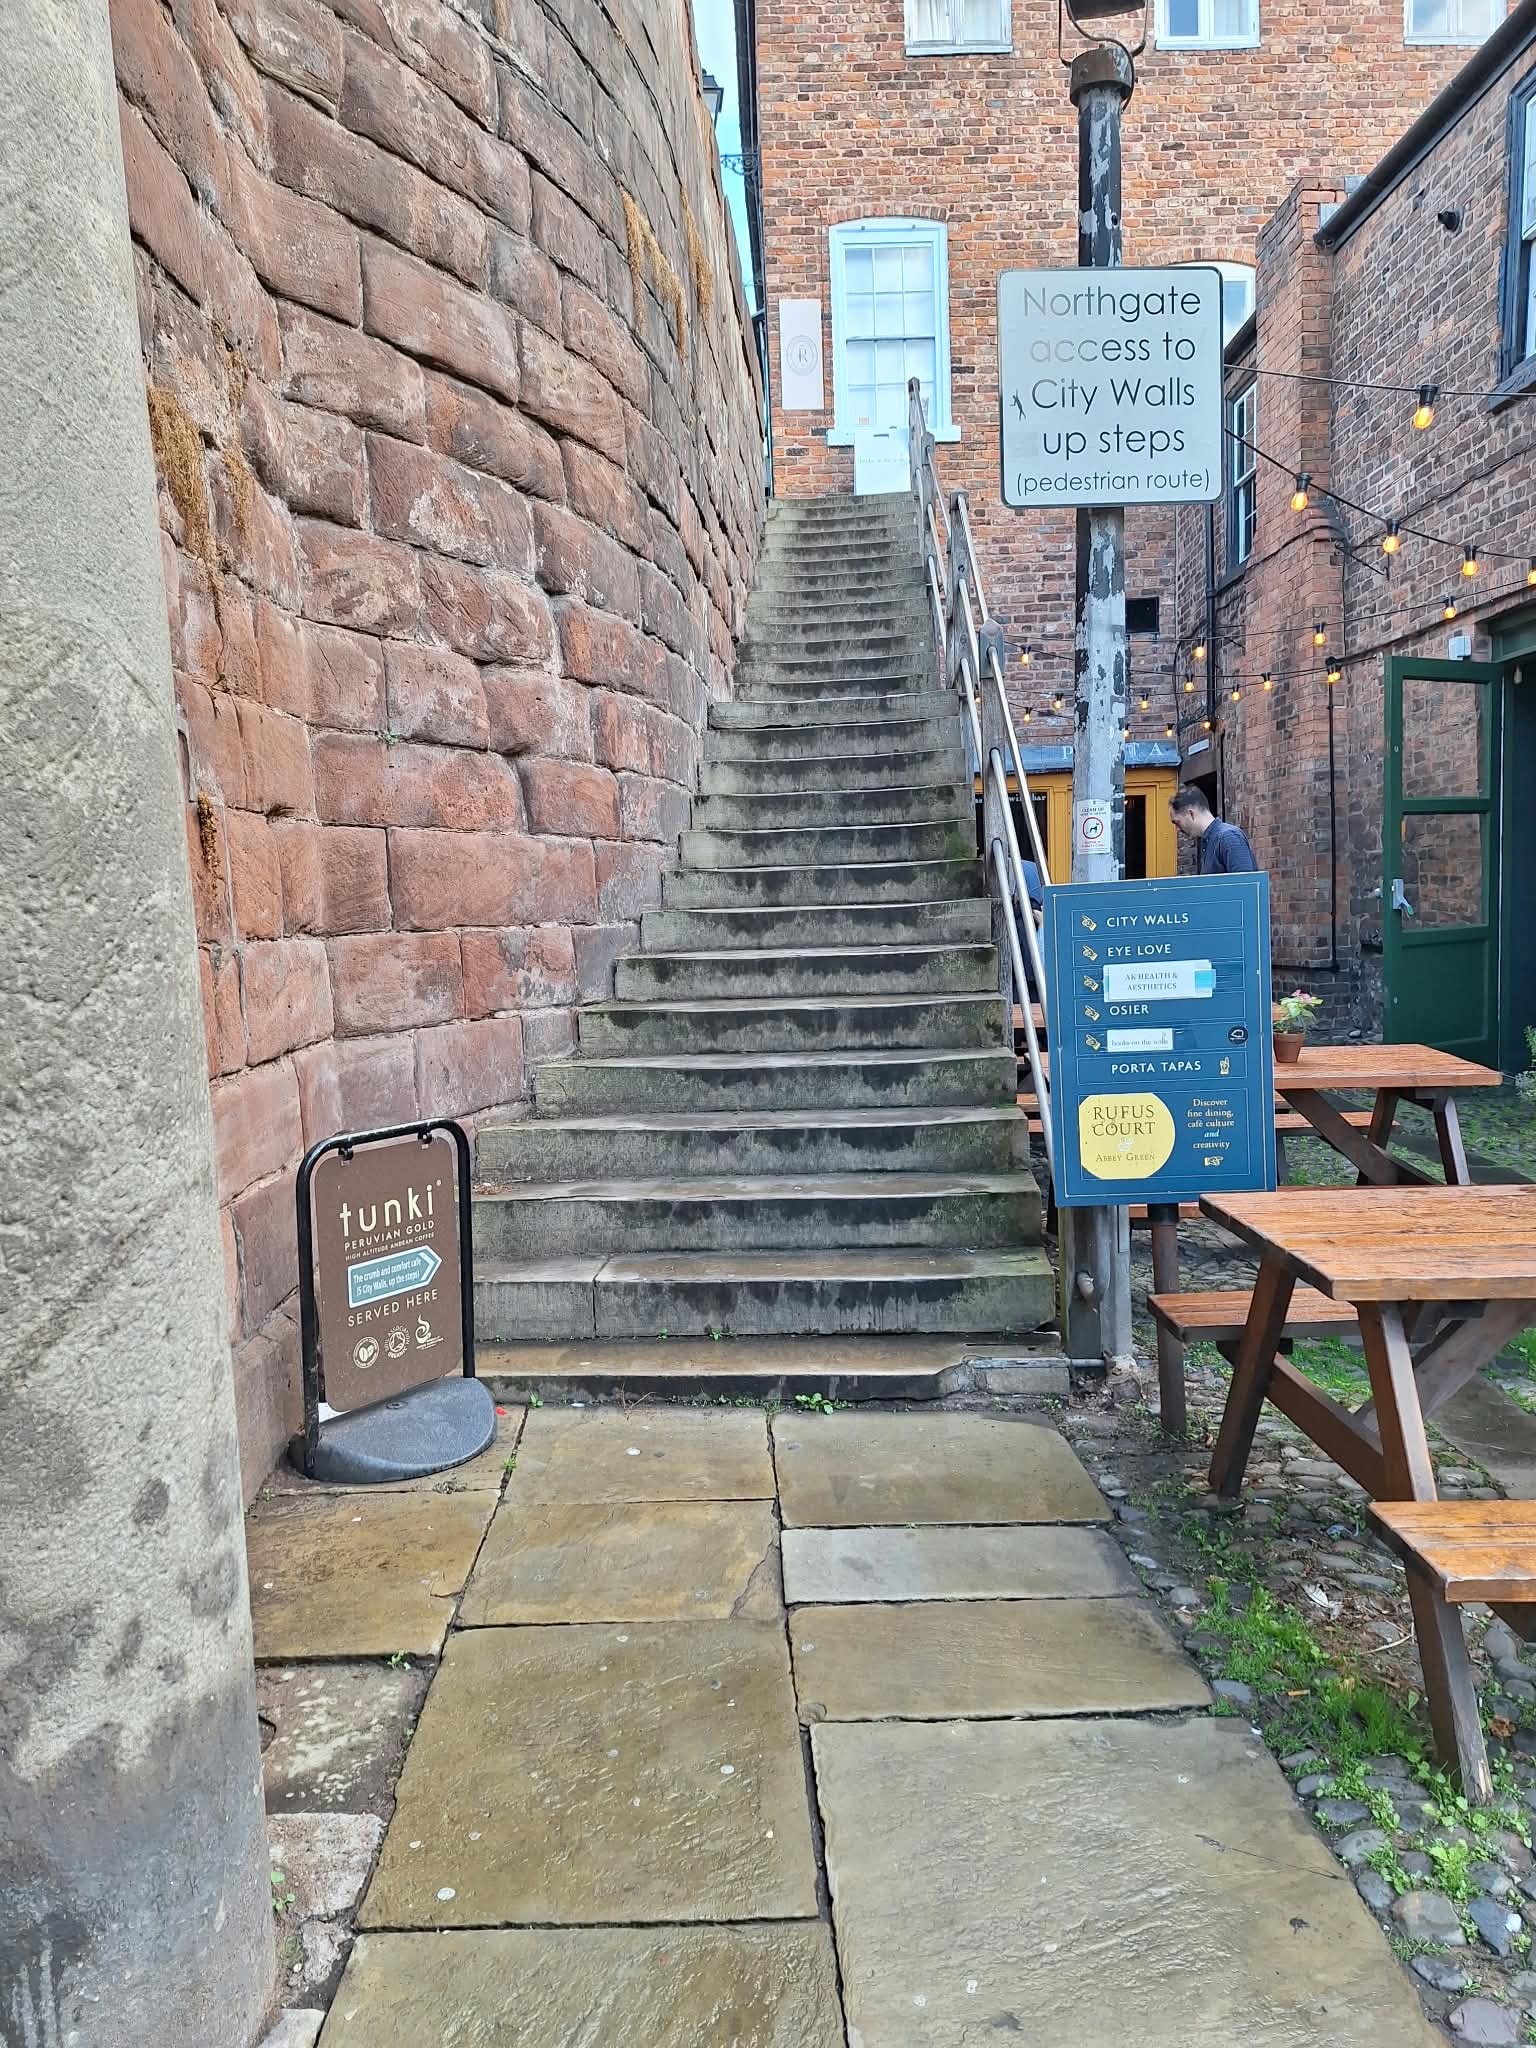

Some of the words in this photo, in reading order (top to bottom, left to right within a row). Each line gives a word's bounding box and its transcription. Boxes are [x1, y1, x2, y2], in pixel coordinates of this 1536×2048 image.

[1023, 286, 1201, 323] Northgate
[1031, 339, 1151, 362] access
[1163, 332, 1196, 361] to
[1031, 378, 1098, 415] City
[1110, 377, 1196, 407] Walls
[1043, 432, 1087, 461] up
[1099, 424, 1185, 459] steps
[1016, 471, 1139, 497] (pedestrian
[1146, 468, 1210, 491] route)
[1106, 915, 1138, 928] CITY
[1144, 912, 1189, 926] WALLS
[1107, 946, 1132, 957] EYE
[1137, 943, 1172, 956] LOVE
[1127, 982, 1177, 991] AESTHETICS
[1109, 1004, 1149, 1016] OSIER
[1111, 1062, 1155, 1074] PORTA
[1160, 1060, 1202, 1072] TAPAS
[1193, 1098, 1228, 1107] Discover
[1093, 1104, 1155, 1120] RUFUS
[1092, 1121, 1156, 1136] COURT
[1205, 1118, 1235, 1127] culture
[1203, 1128, 1220, 1138] and
[1192, 1139, 1231, 1150] creativity
[339, 1184, 435, 1237] tunki
[344, 1229, 401, 1252] PERUVIAN
[406, 1220, 435, 1235] GOLD
[345, 1251, 361, 1262] HIGH
[362, 1244, 389, 1257] ALTITUDE
[390, 1237, 414, 1249] ANDEAN
[414, 1231, 435, 1242] COFFEE
[353, 1273, 364, 1284] The
[363, 1268, 381, 1280] crumb
[380, 1265, 391, 1276] and
[347, 1301, 400, 1327] SERVED
[406, 1288, 439, 1309] HERE
